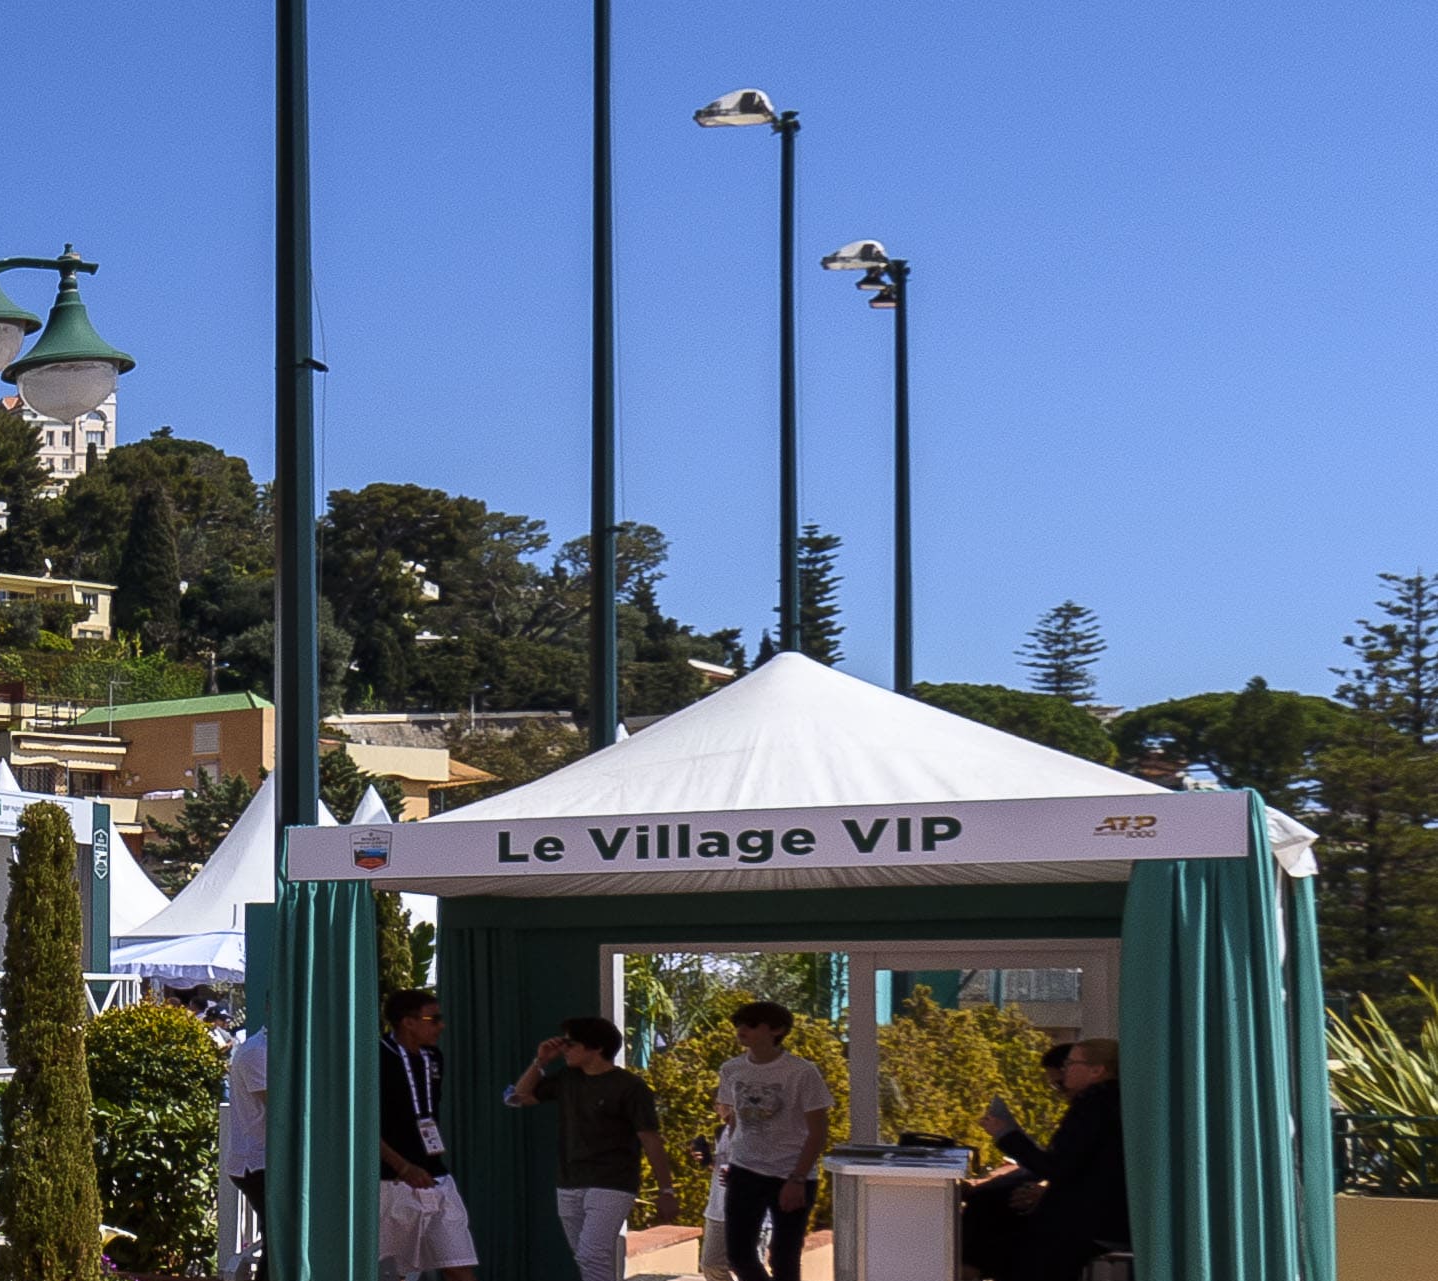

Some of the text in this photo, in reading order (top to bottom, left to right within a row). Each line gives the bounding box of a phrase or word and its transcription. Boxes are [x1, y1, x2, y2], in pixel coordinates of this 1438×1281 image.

[497, 816, 963, 864] Le Village VIP
